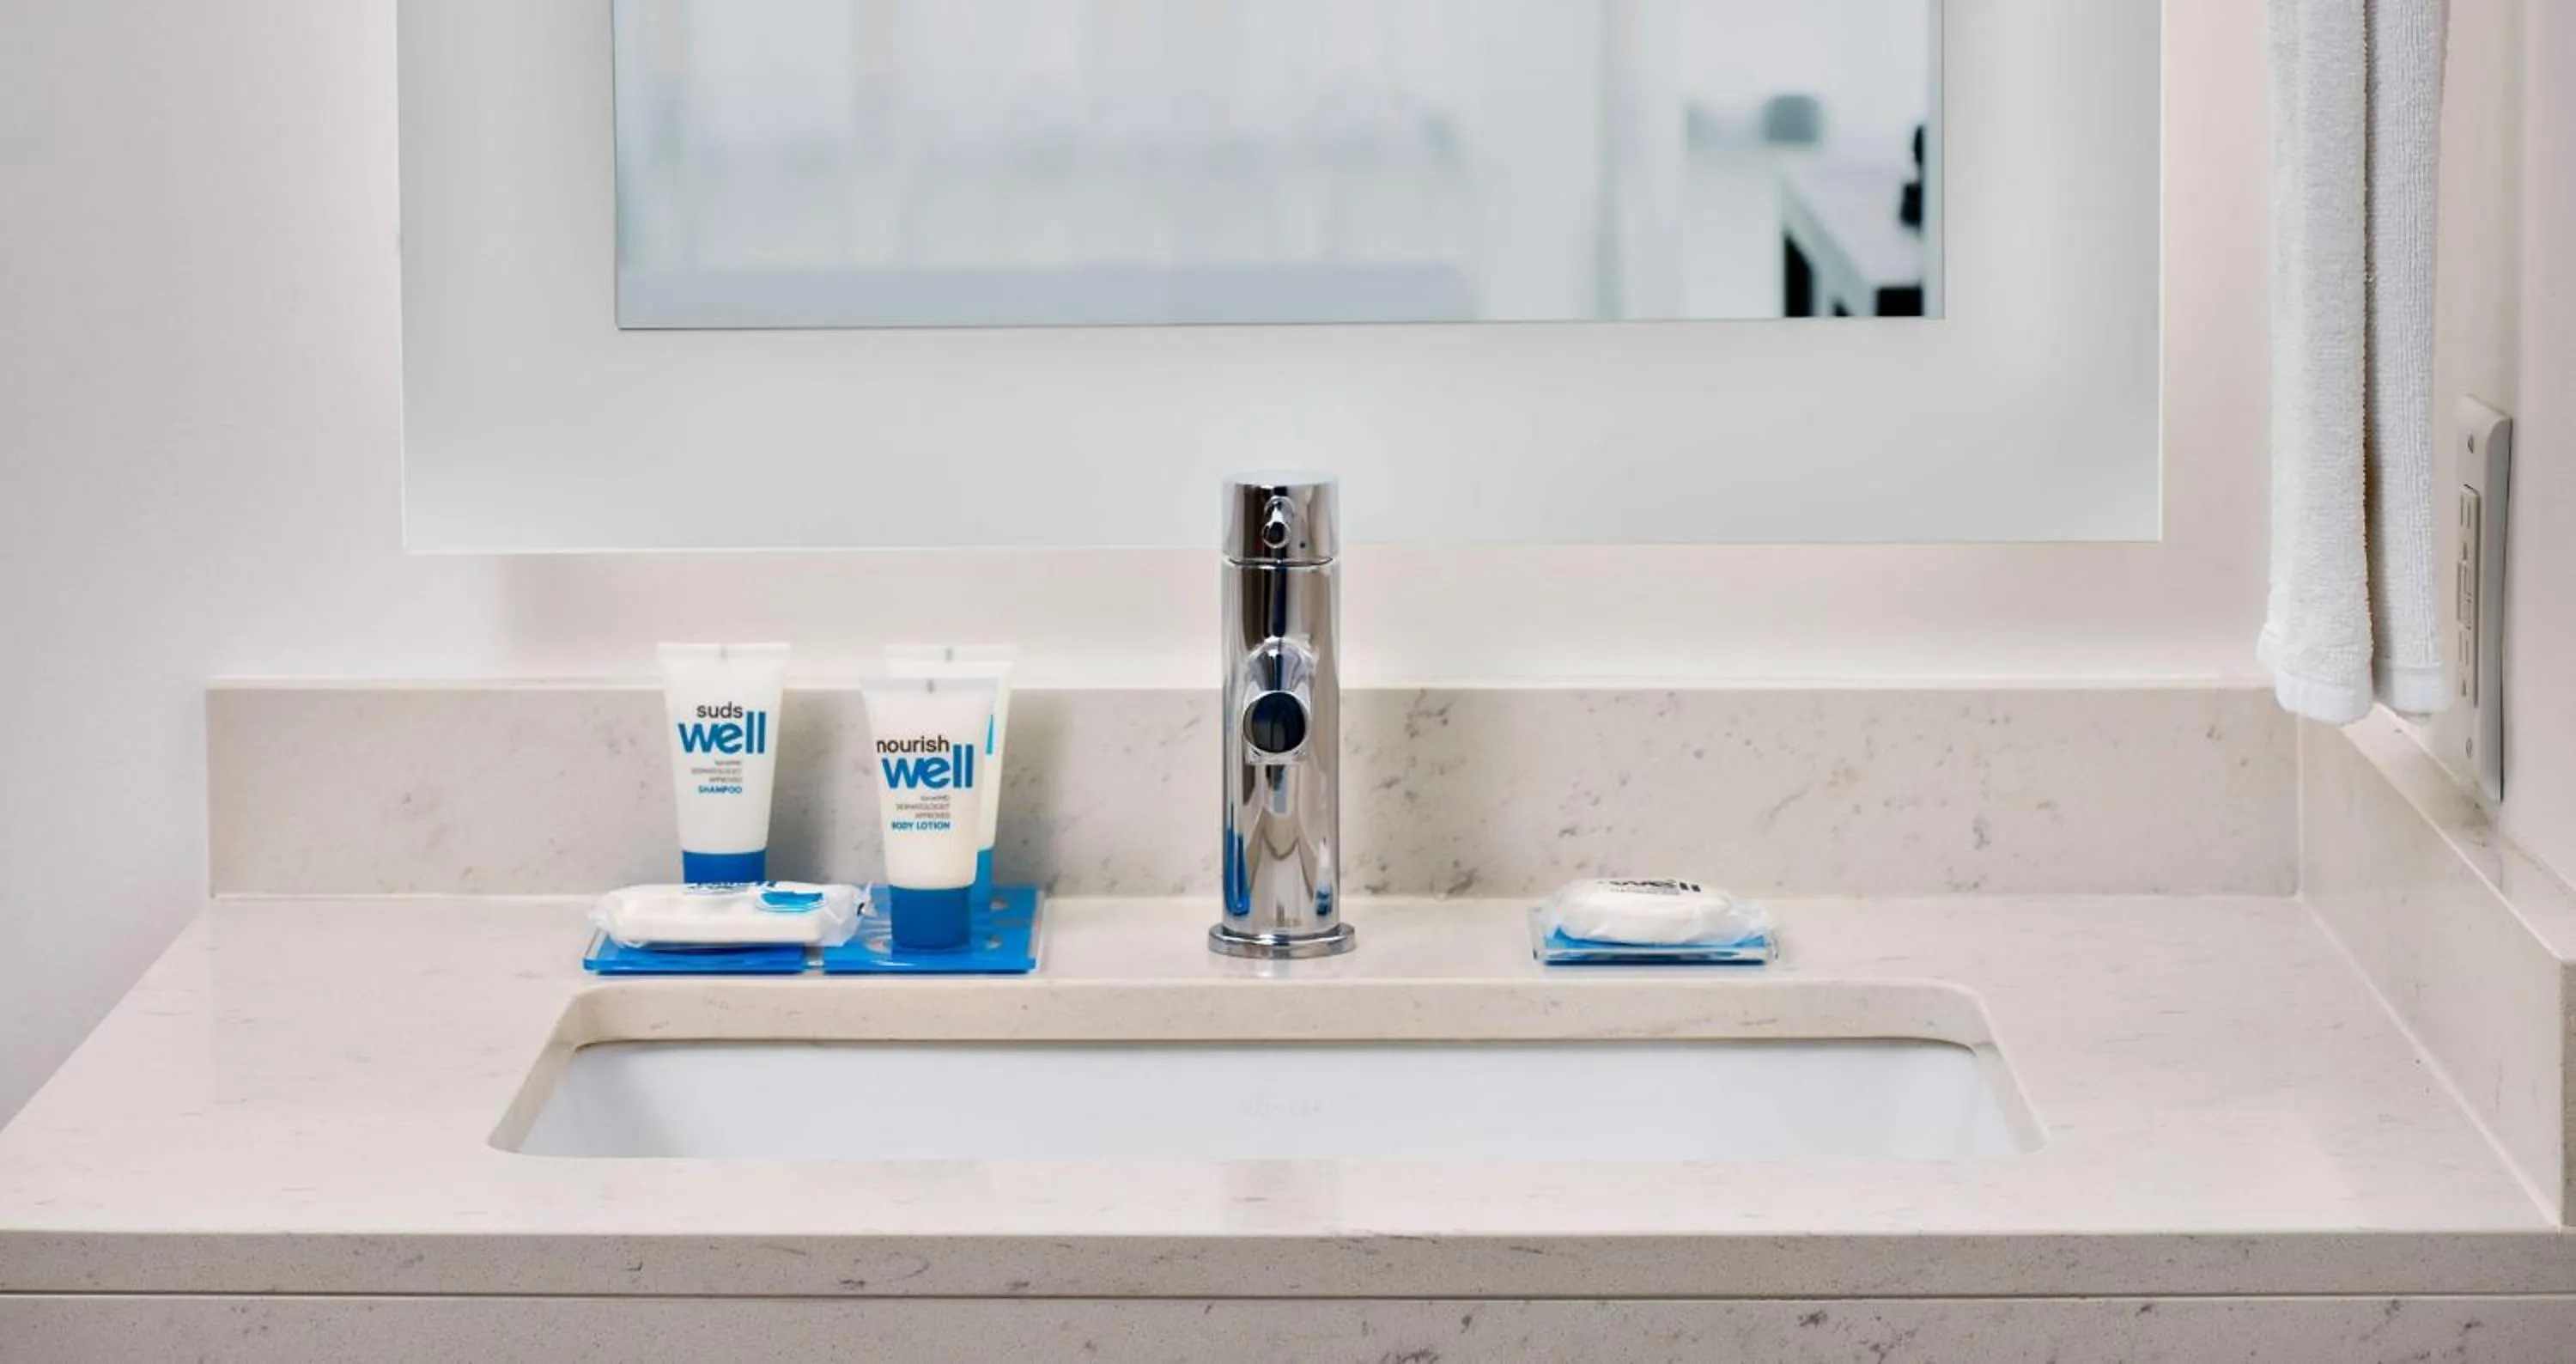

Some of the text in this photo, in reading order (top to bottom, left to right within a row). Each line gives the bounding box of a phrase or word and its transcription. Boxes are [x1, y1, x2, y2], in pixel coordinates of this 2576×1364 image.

[696, 701, 743, 719] suds
[677, 710, 766, 754] well
[877, 735, 950, 753] nourish
[881, 744, 974, 789] well
[698, 785, 743, 795] SHAMPOO
[891, 821, 951, 831] BODY LOTION
